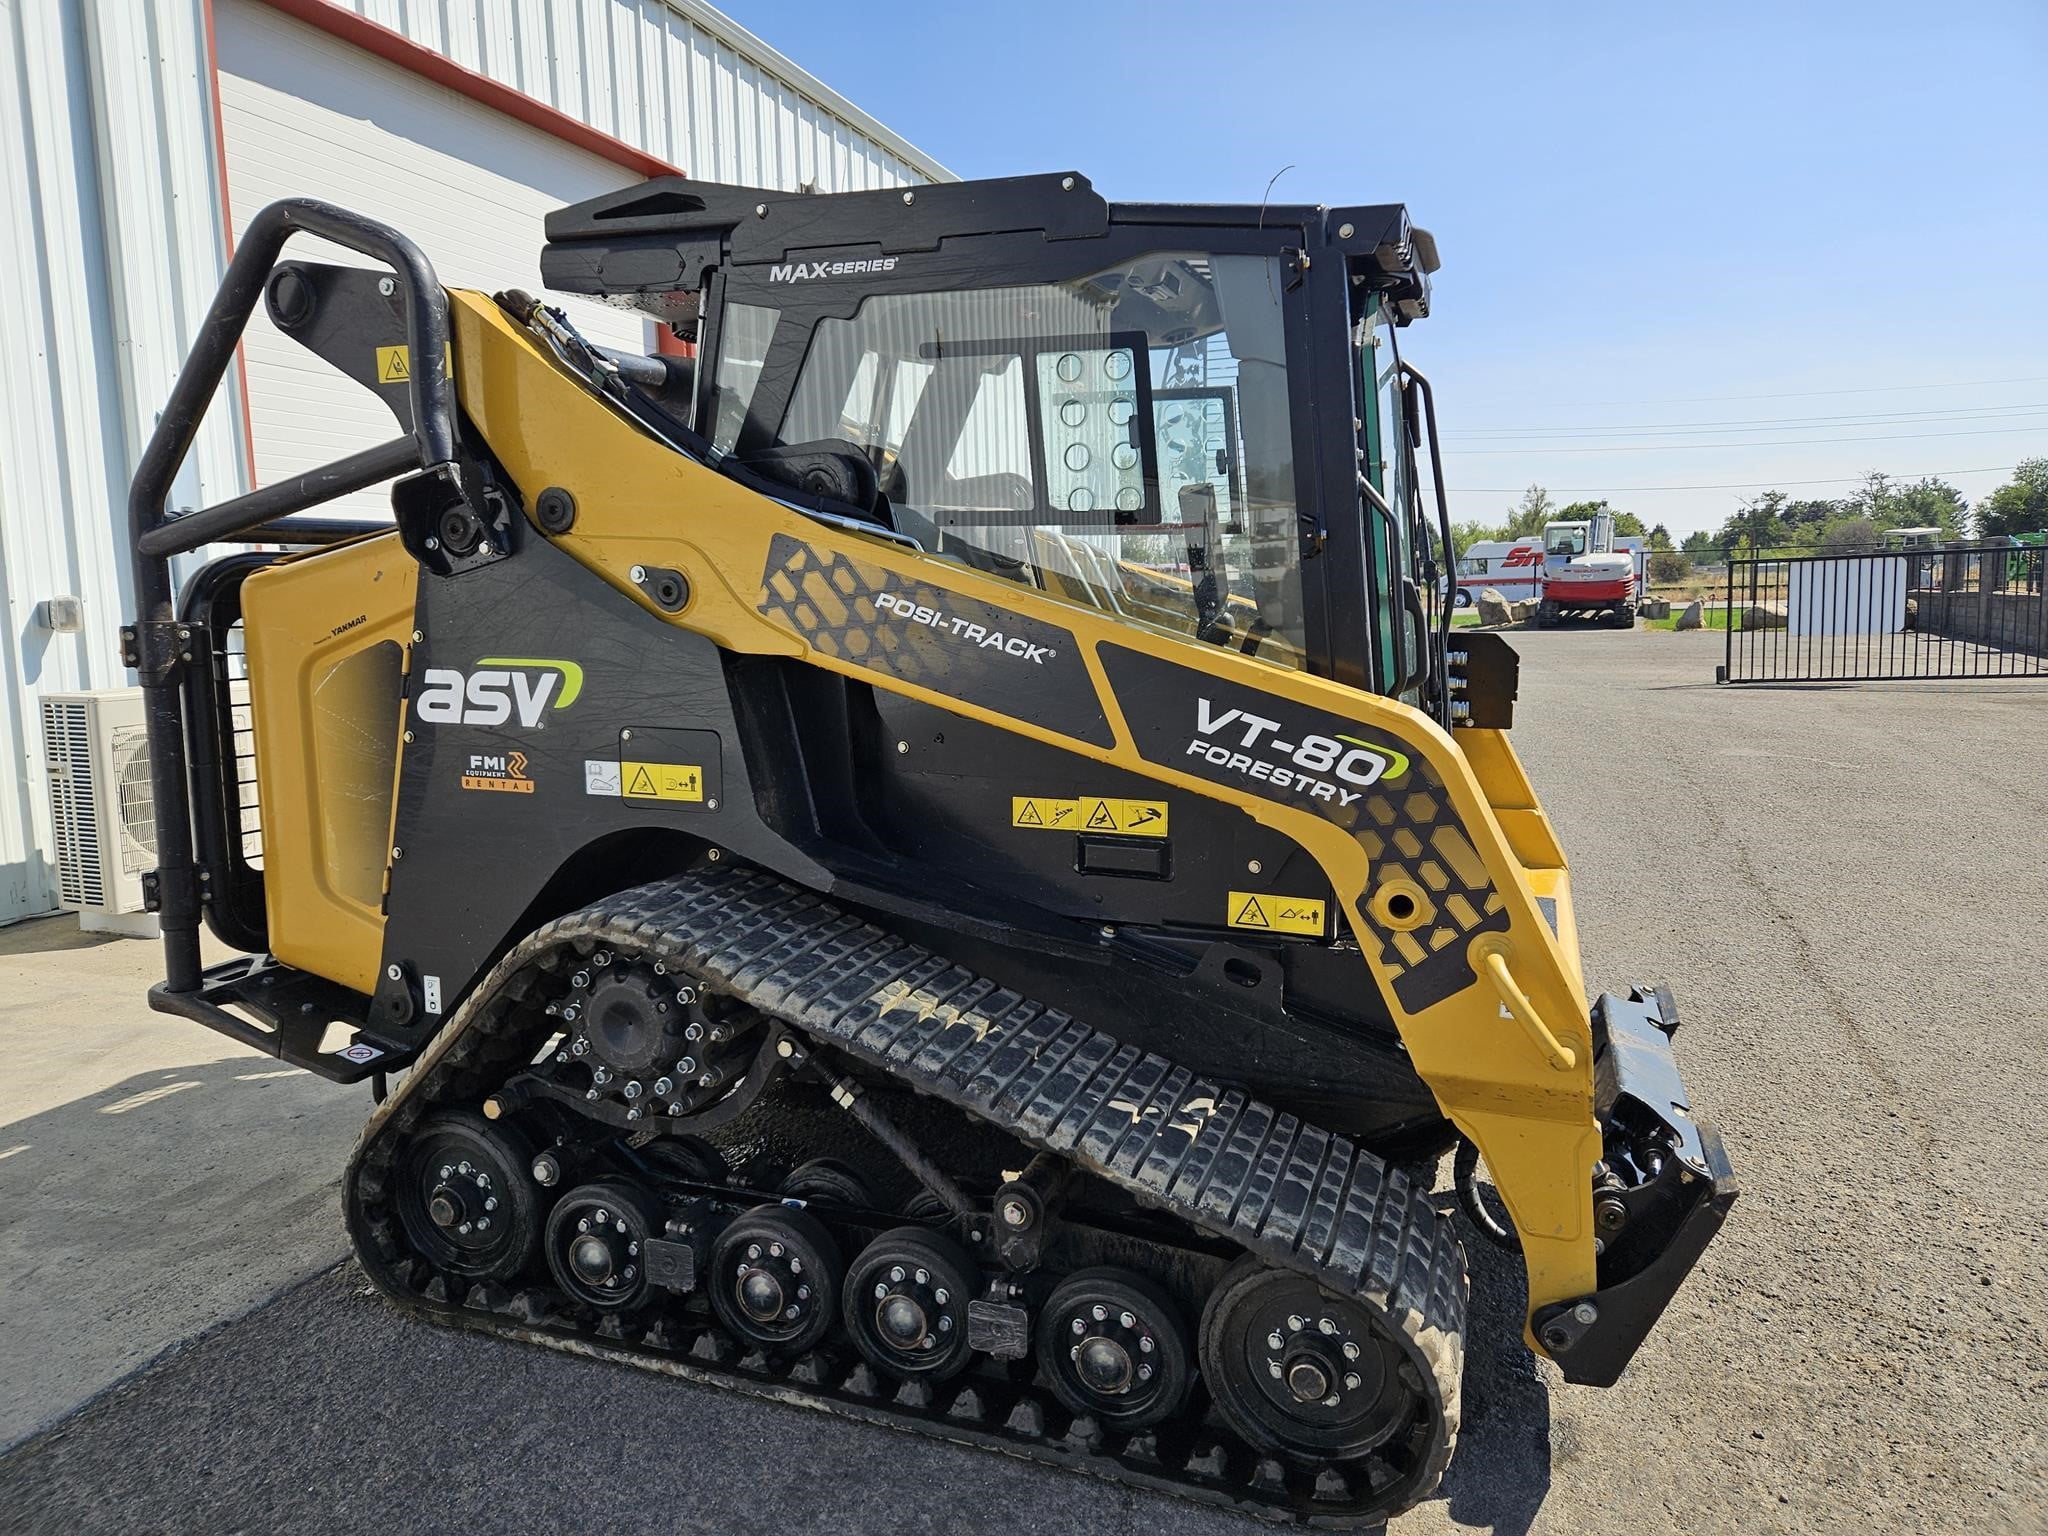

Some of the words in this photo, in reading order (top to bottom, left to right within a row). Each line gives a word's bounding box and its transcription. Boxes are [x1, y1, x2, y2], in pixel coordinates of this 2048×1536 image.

[769, 257, 895, 284] MAX-SERIES
[331, 614, 367, 636] YANMAR
[874, 592, 1050, 664] POSI-TRACK
[1197, 697, 1386, 786] VT-80
[465, 769, 507, 778] EQUIPMENT
[470, 755, 506, 771] FMI
[1185, 739, 1362, 807] FORESTRY
[465, 779, 531, 791] RENTAL
